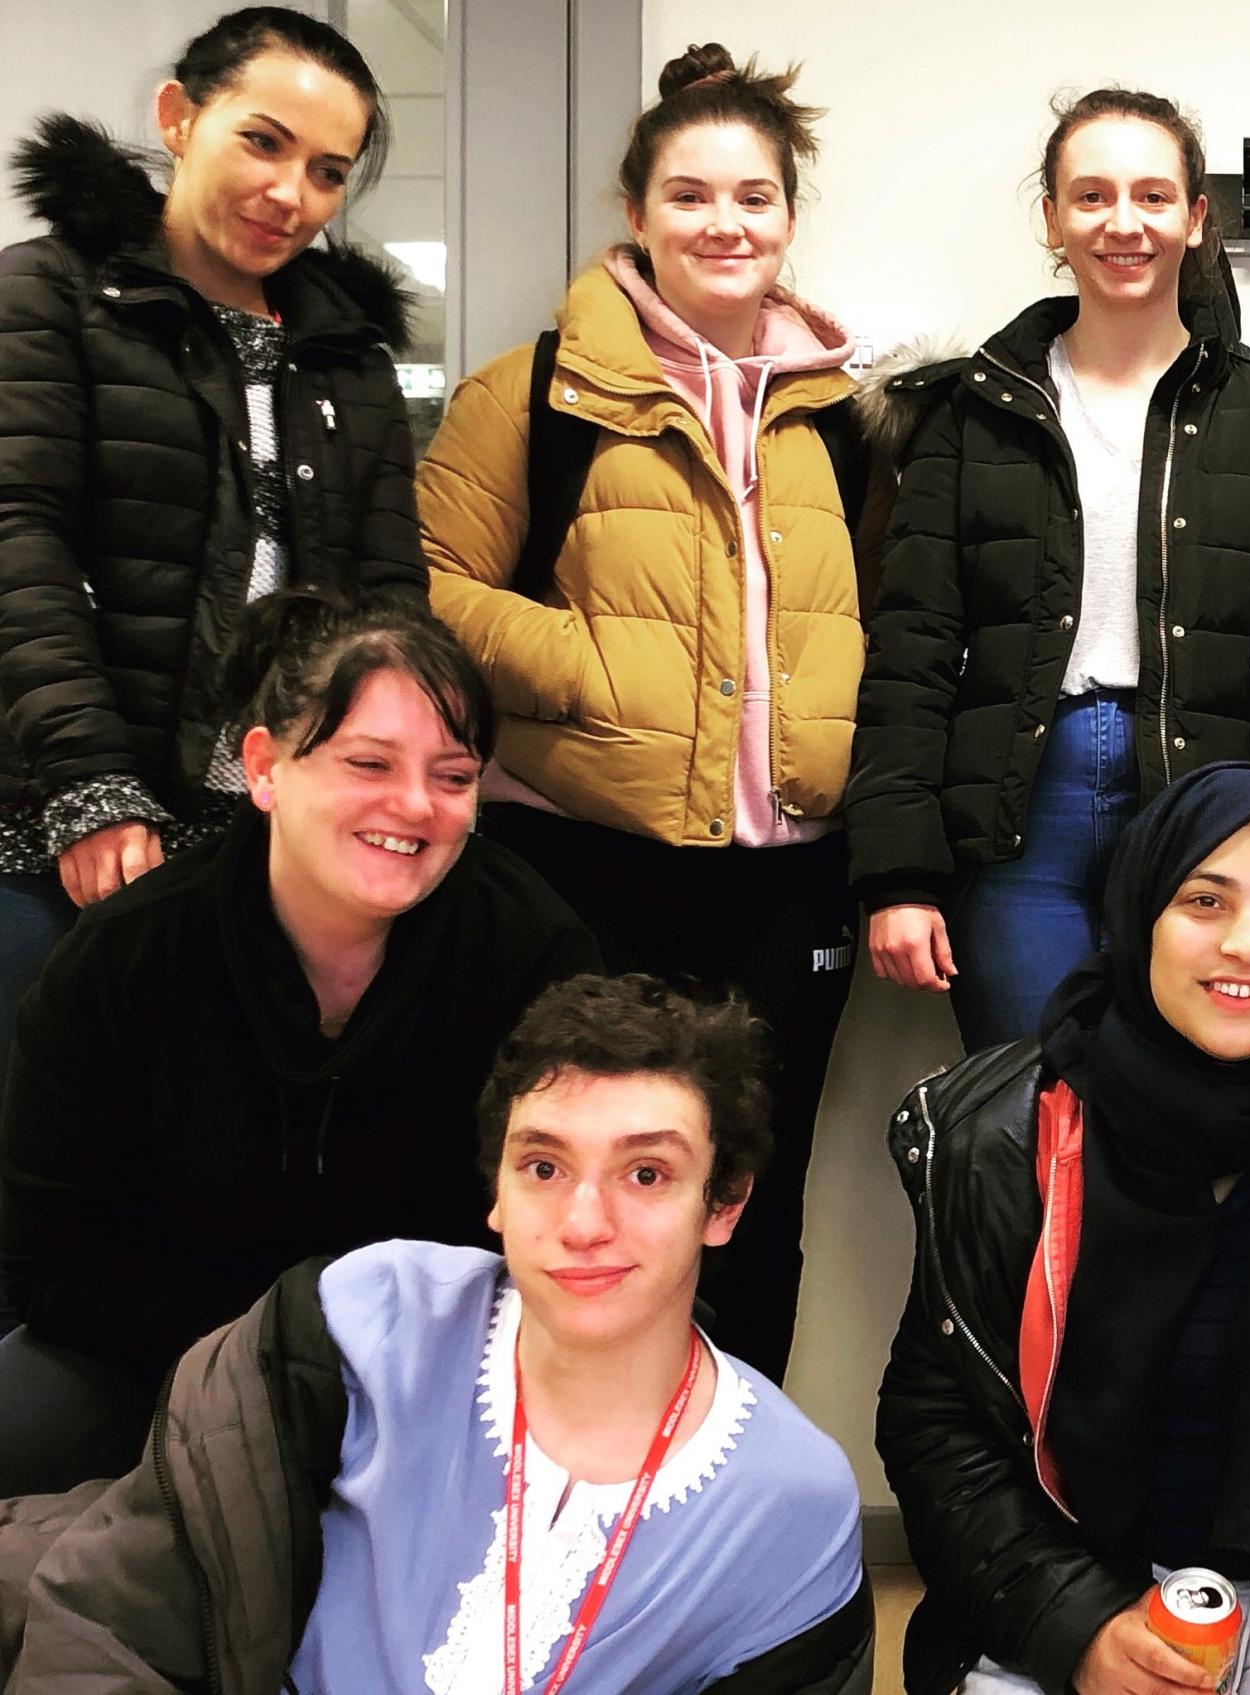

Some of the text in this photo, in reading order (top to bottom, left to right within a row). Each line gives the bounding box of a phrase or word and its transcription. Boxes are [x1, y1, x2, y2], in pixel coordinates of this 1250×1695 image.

[508, 1443, 522, 1562] MIDDLESEX UNIVERSITY
[506, 1604, 517, 1664] MIDDLESEX
